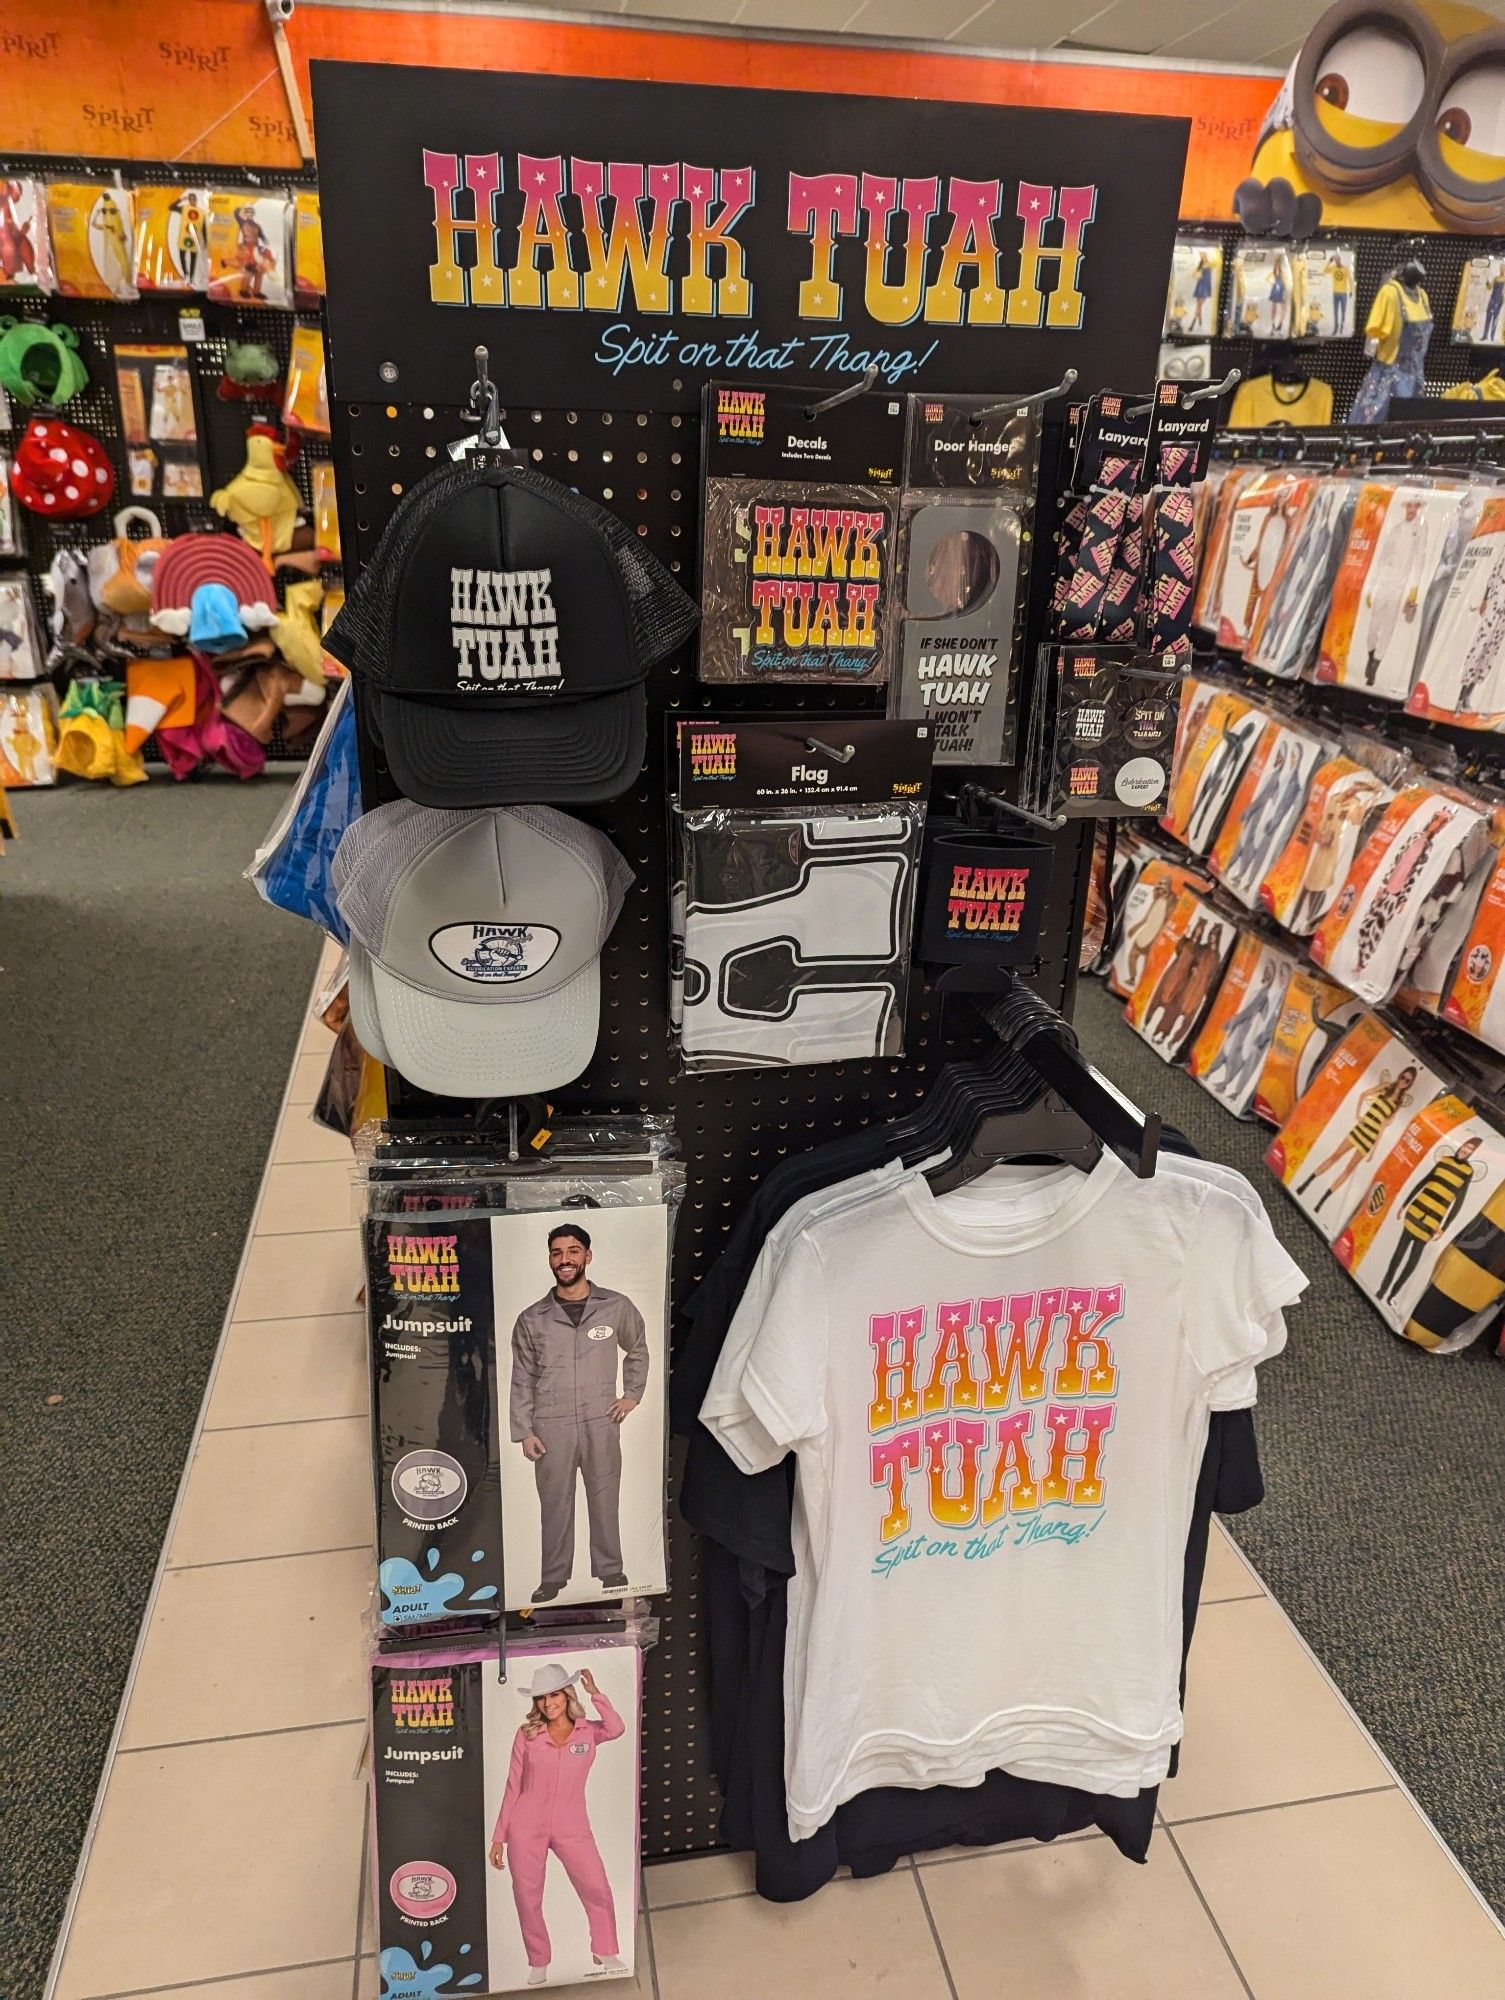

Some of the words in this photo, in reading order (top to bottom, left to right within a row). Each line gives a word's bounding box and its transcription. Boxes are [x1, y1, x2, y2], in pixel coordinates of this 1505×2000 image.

[1, 31, 60, 59] PIRIT
[159, 41, 231, 72] SPIRIT
[82, 103, 156, 133] SPIRIT
[1197, 116, 1257, 140] SPIRIT
[423, 148, 756, 318] HAWK
[787, 171, 1099, 330] TUAH
[595, 324, 680, 376] Spit
[678, 342, 723, 367] on
[725, 330, 806, 369] that
[809, 332, 940, 385] Thang!
[1160, 384, 1179, 395] HAWK
[718, 389, 766, 415] HAWK
[1103, 397, 1123, 408] HAWK
[1160, 394, 1178, 404] TUAH
[925, 403, 944, 413] HAWK
[1101, 406, 1121, 417] TUAH
[925, 412, 944, 422] TUAH
[718, 413, 766, 438] TUAH
[1158, 418, 1210, 436] Lanyard
[787, 435, 828, 450] Decals
[934, 439, 965, 452] Door
[968, 440, 1013, 455] Hanger
[781, 451, 803, 460] Includes
[815, 453, 832, 461] Decals
[868, 467, 893, 479] SPIRIT
[991, 467, 1022, 480] SPIRIT
[753, 505, 884, 581] HAWK
[450, 567, 557, 626] HAWK
[752, 579, 881, 650] TUAH
[920, 638, 932, 649] IF
[933, 638, 958, 650] SHE
[960, 638, 998, 650] DON'T
[451, 626, 561, 680] TUAH
[751, 651, 782, 671] Spit
[782, 656, 798, 667] on
[800, 650, 825, 668] that
[828, 651, 873, 673] Thang!
[918, 653, 998, 680] HAWK
[1074, 657, 1096, 668] HAWK
[1074, 667, 1096, 677] TUAH
[920, 681, 991, 706] TUAH
[925, 709, 930, 719] I
[935, 709, 982, 724] WON'T
[1077, 708, 1105, 723] HAWK
[1135, 709, 1153, 720] SPIT
[1154, 711, 1165, 720] ON
[935, 724, 970, 738] TALK
[1075, 722, 1103, 737] TUAH
[691, 733, 736, 754] HAWK
[691, 753, 736, 774] TUAH
[791, 765, 829, 785] Flag
[1070, 766, 1099, 782] HAWK
[756, 788, 765, 796] 60
[804, 786, 820, 794] 152.4
[835, 785, 849, 794] 91.4
[892, 781, 923, 795] SPIRIT
[1070, 780, 1098, 795] TUAH
[949, 865, 1030, 901] HAWK
[948, 898, 1024, 931] TUAH
[472, 925, 528, 940] HAWK
[387, 1234, 458, 1264] HAWK
[389, 1263, 461, 1293] TUAH
[383, 1314, 473, 1337] Jumpsuit
[385, 1342, 422, 1353] INCLUDES:
[385, 1351, 417, 1360] Jumpsuit
[867, 1282, 1126, 1434] HAWK
[869, 1402, 1116, 1544] TUAH
[402, 1517, 436, 1532] PRINTED
[436, 1516, 460, 1531] BACK
[871, 1534, 928, 1579] Spit
[926, 1540, 960, 1558] on
[963, 1525, 1009, 1560] that
[1013, 1508, 1108, 1548] Thang!
[393, 1602, 430, 1614] ADULT
[391, 1678, 453, 1703] HAWK
[392, 1702, 455, 1728] TUAH
[384, 1745, 464, 1765] Jumpsuit
[385, 1770, 419, 1778] INCLUDES:
[400, 1915, 429, 1927] PRINTED
[430, 1915, 449, 1926] BACK
[391, 1990, 422, 2000] ADULT
